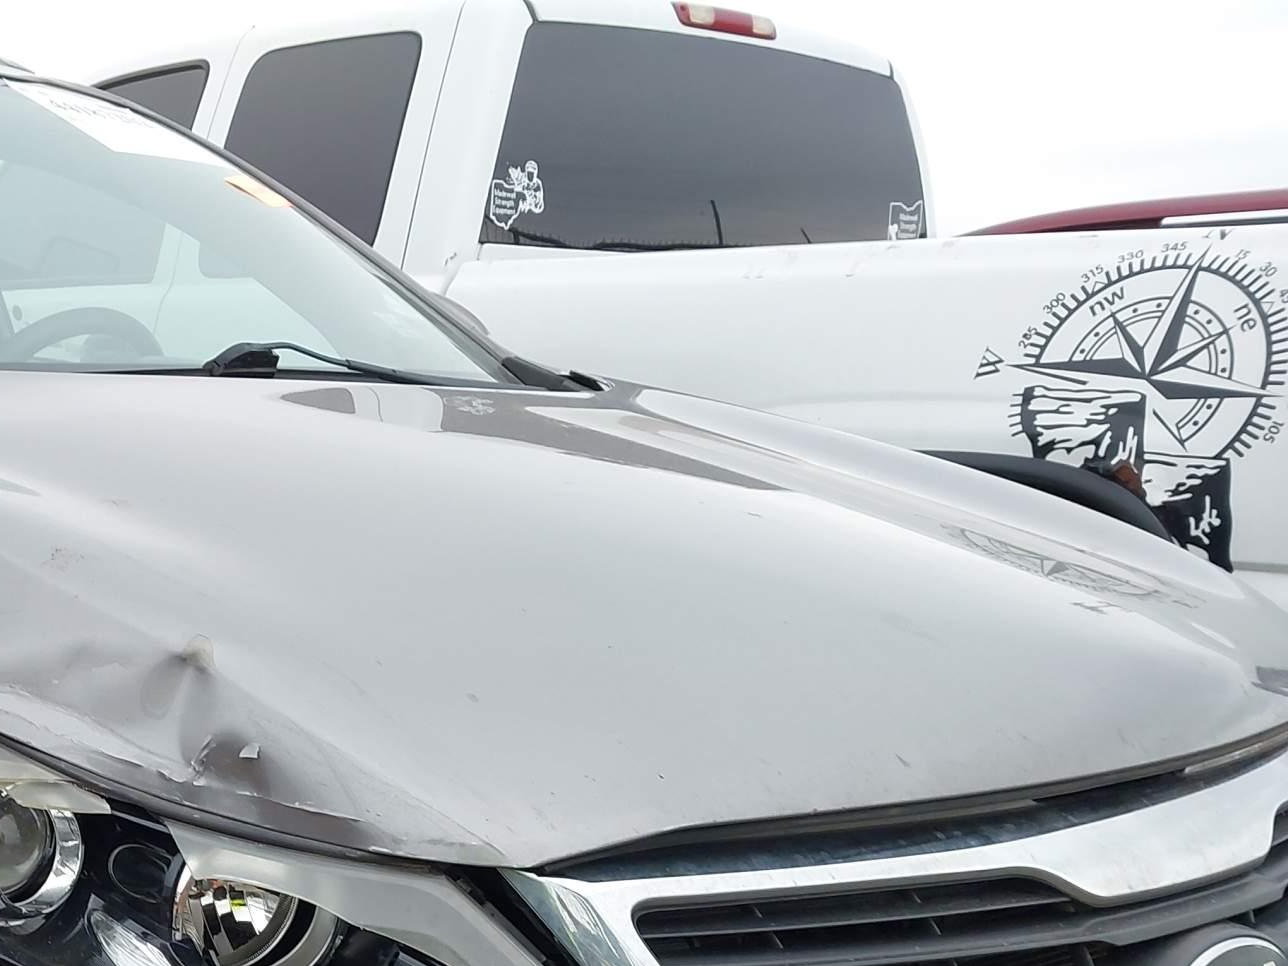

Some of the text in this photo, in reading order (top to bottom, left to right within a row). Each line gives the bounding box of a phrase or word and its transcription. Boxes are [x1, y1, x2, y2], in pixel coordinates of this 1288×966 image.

[1117, 249, 1144, 262] 330
[1161, 241, 1188, 253] 345
[1235, 249, 1251, 260] 15
[1080, 264, 1104, 284] 315
[1259, 261, 1278, 278] 30
[1042, 292, 1066, 315] 300
[1089, 286, 1125, 316] nw
[1233, 302, 1258, 332] ne
[1018, 326, 1038, 349] 285
[1263, 421, 1284, 444] 105
